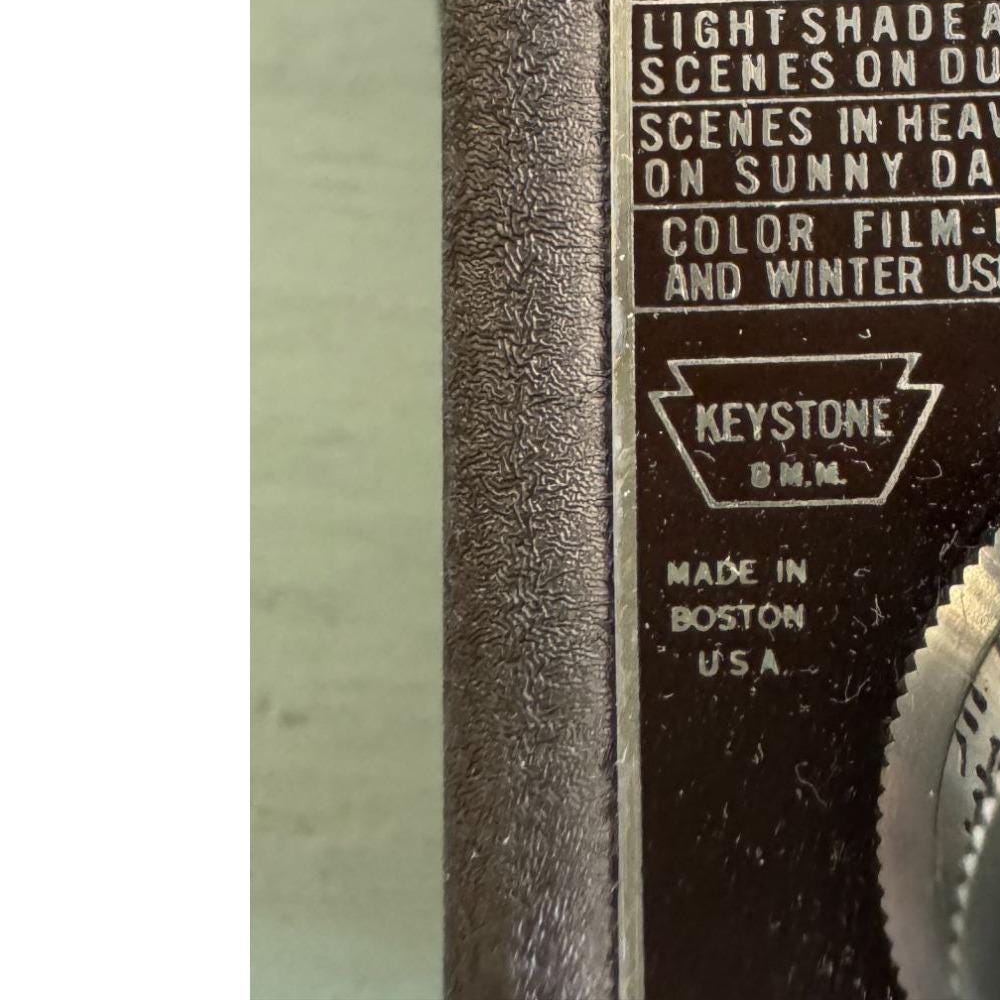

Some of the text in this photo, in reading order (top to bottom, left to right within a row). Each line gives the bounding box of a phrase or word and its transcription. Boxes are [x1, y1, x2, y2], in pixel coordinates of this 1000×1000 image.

[643, 5, 786, 50] LIGHT
[801, 2, 966, 45] SHADE
[640, 50, 835, 95] SCENES
[856, 49, 916, 88] ON
[638, 106, 812, 154] SCENES
[837, 105, 882, 144] IN
[645, 158, 703, 198] ON
[735, 152, 903, 195] SUNNY
[663, 214, 813, 255] COLOR
[665, 262, 740, 301] AND
[766, 256, 923, 298] WINTER
[695, 395, 894, 445] KEYSTONE
[667, 557, 807, 587] MADE IN
[671, 605, 804, 631] BOSTON
